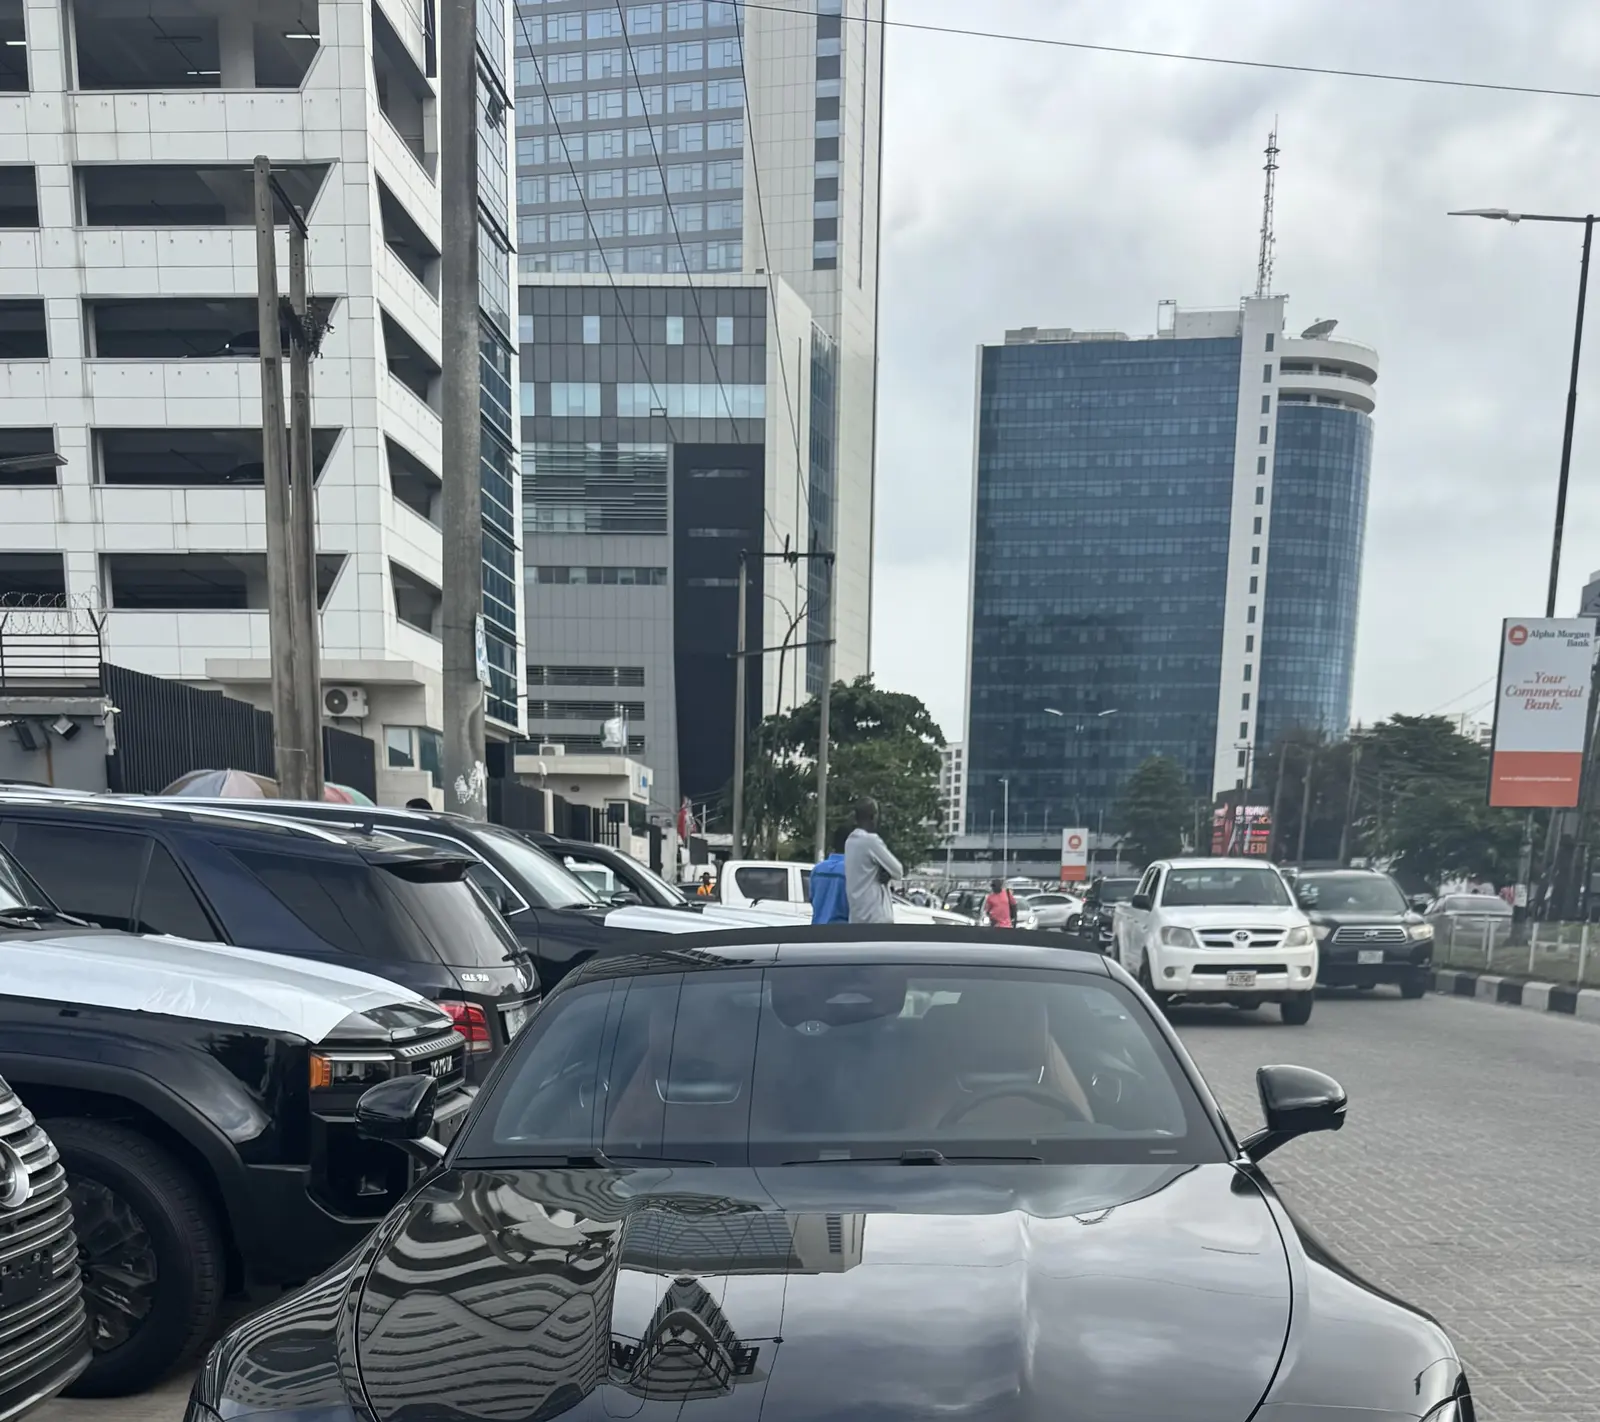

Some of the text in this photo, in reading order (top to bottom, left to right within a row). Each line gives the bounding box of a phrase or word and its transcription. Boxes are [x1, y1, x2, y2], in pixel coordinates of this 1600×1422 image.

[1530, 630, 1590, 640] Alpha Morgan
[1566, 639, 1589, 647] Bank
[1505, 684, 1584, 698] Commercial
[1524, 698, 1562, 710] Bank.
[430, 1055, 453, 1077] TOYOTA
